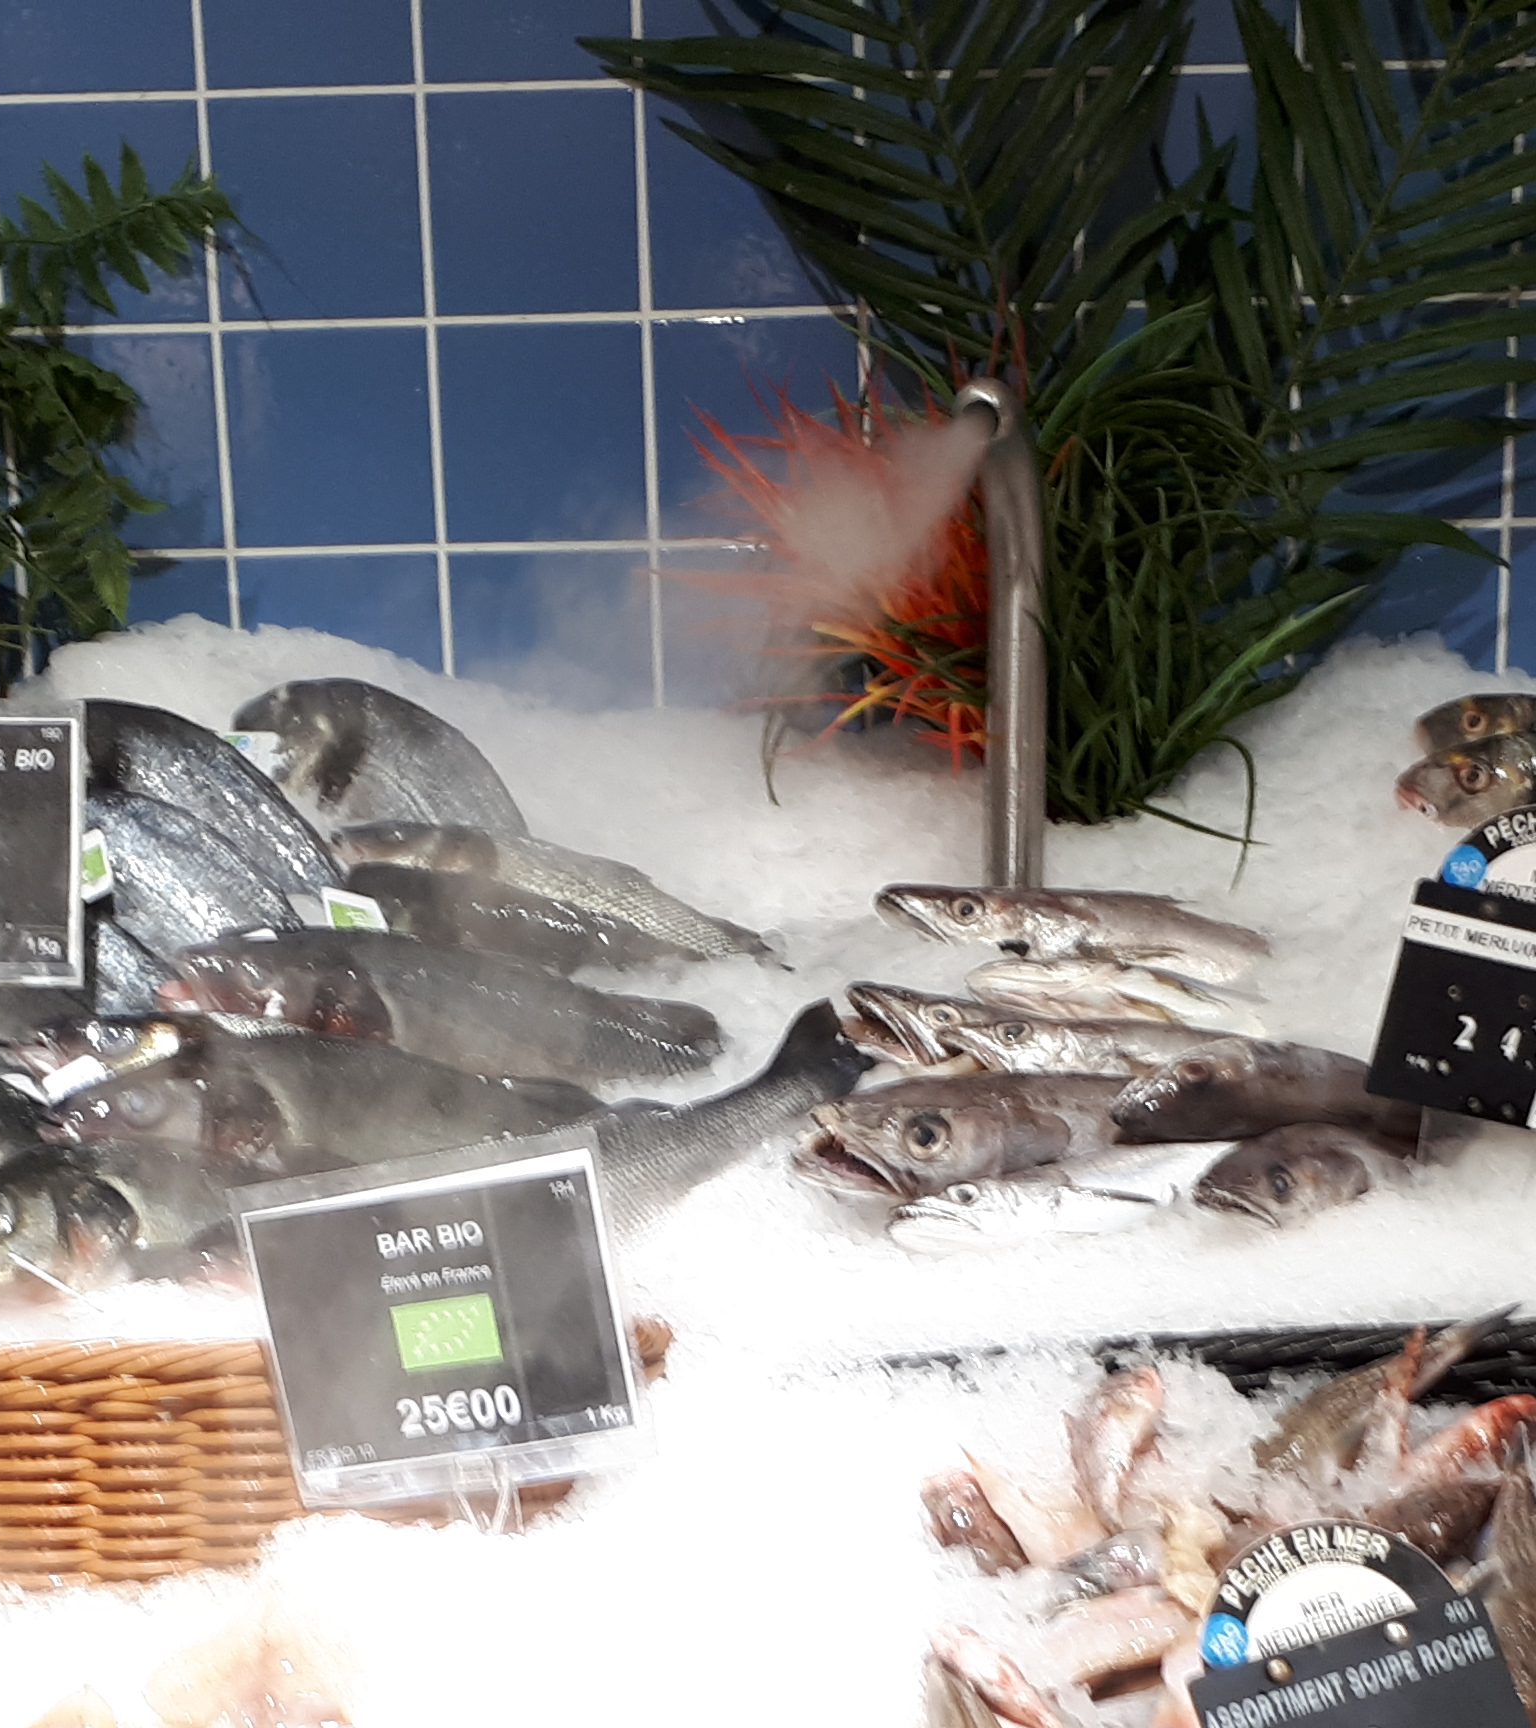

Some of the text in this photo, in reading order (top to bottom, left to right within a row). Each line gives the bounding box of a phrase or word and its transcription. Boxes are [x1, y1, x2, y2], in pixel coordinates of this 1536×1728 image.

[15, 749, 55, 770] BIO
[1408, 915, 1459, 940] PETIT
[377, 1221, 483, 1258] BAR BIO
[441, 1264, 492, 1285] France
[396, 1384, 522, 1439] 25€00
[1291, 1526, 1328, 1556] EN
[1333, 1525, 1391, 1563] MER
[1299, 1592, 1346, 1620] MER
[1256, 1592, 1409, 1659] MÉDITERRANÉE
[1345, 1649, 1422, 1699] SOUPE
[1416, 1626, 1495, 1676] ROCHE
